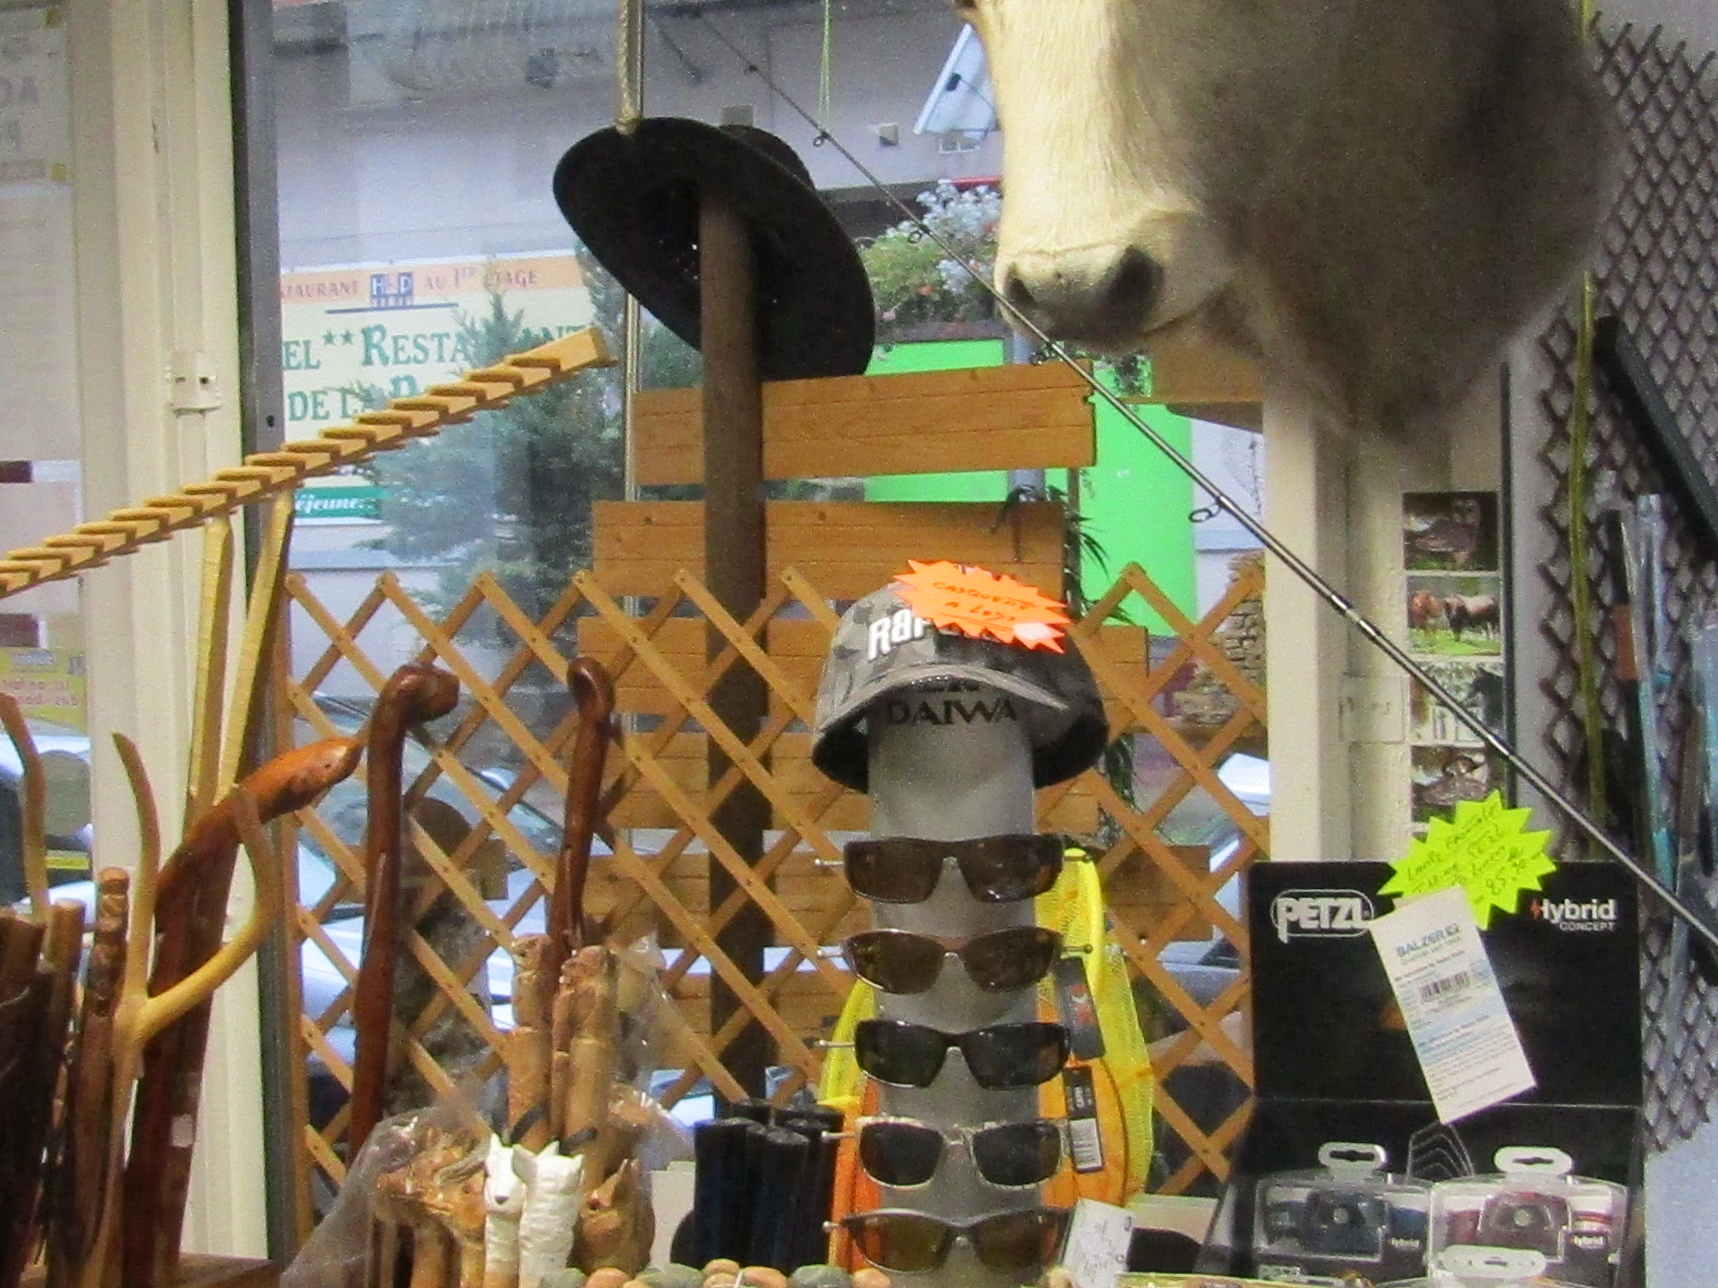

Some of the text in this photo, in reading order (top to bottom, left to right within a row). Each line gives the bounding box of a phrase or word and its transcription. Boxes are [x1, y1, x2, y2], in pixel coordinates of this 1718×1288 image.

[288, 390, 330, 421] DE
[888, 698, 1019, 726] DAIWA
[1277, 898, 1366, 943] PETZL
[1396, 929, 1447, 958] BALZER
